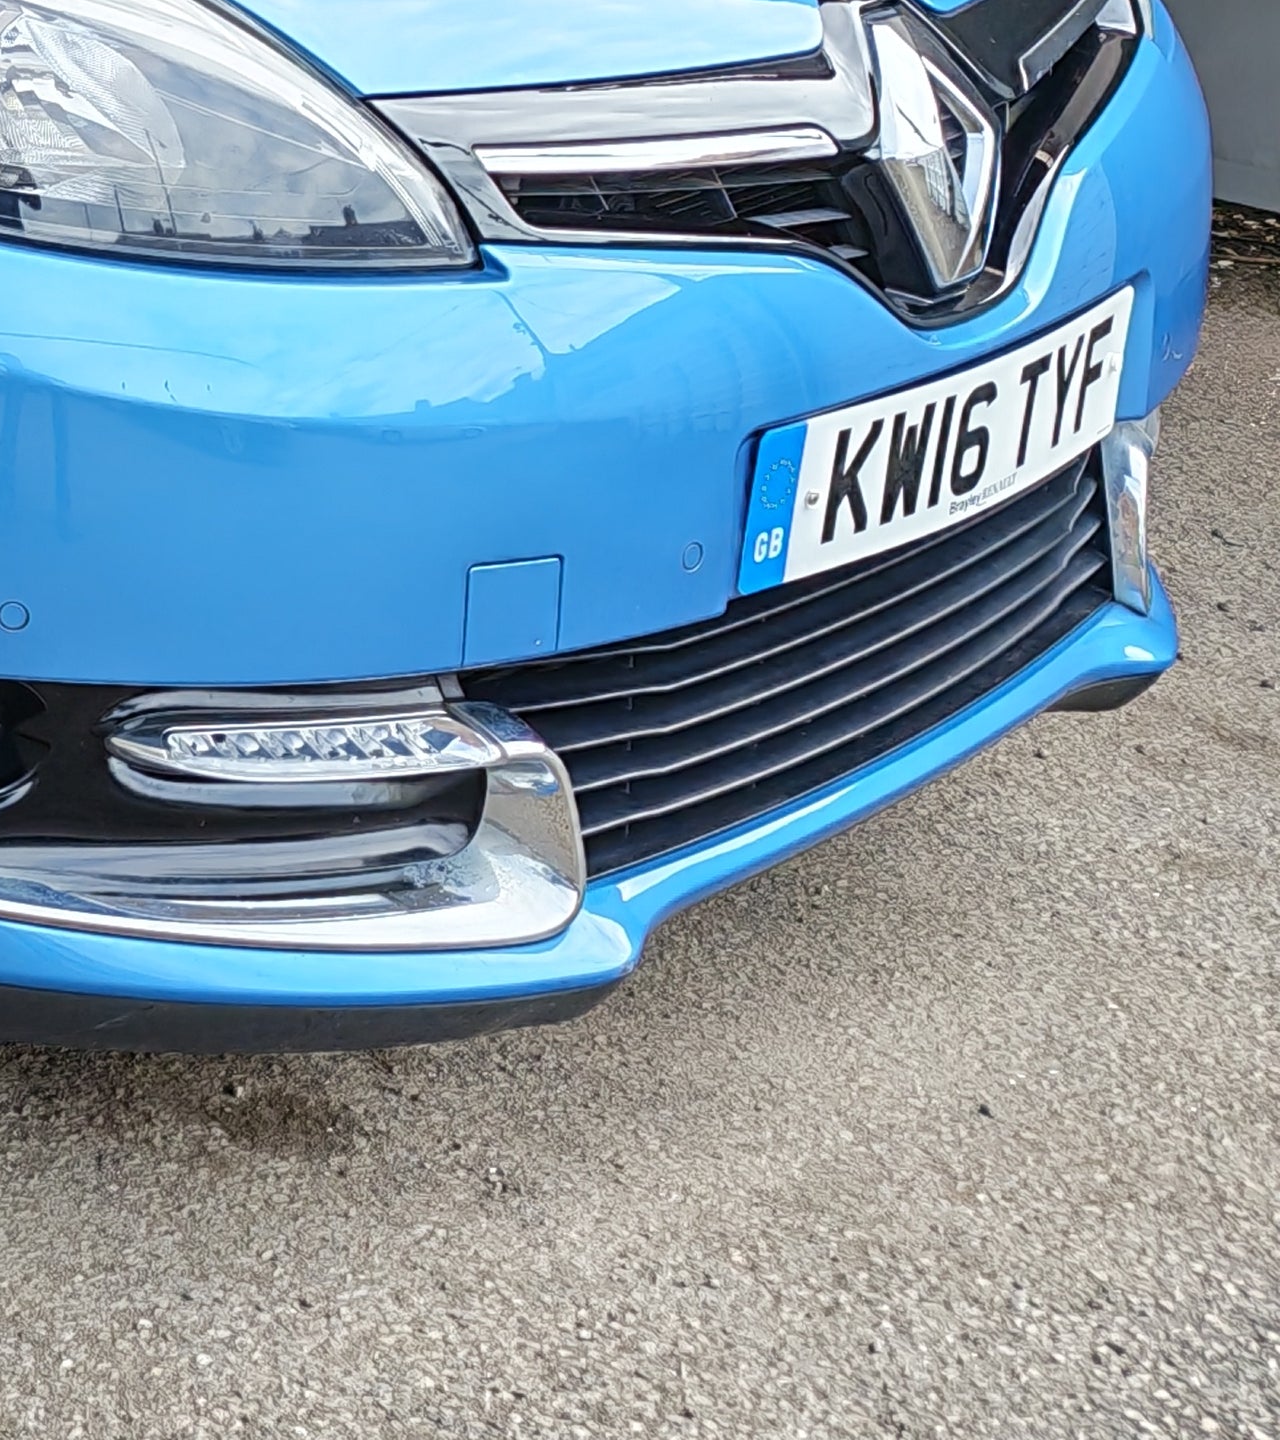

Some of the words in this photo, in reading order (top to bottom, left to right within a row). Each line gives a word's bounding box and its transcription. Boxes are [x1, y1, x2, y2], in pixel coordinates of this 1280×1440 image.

[820, 382, 997, 545] KW16
[1015, 315, 1114, 468] TYF
[754, 527, 784, 564] GB
